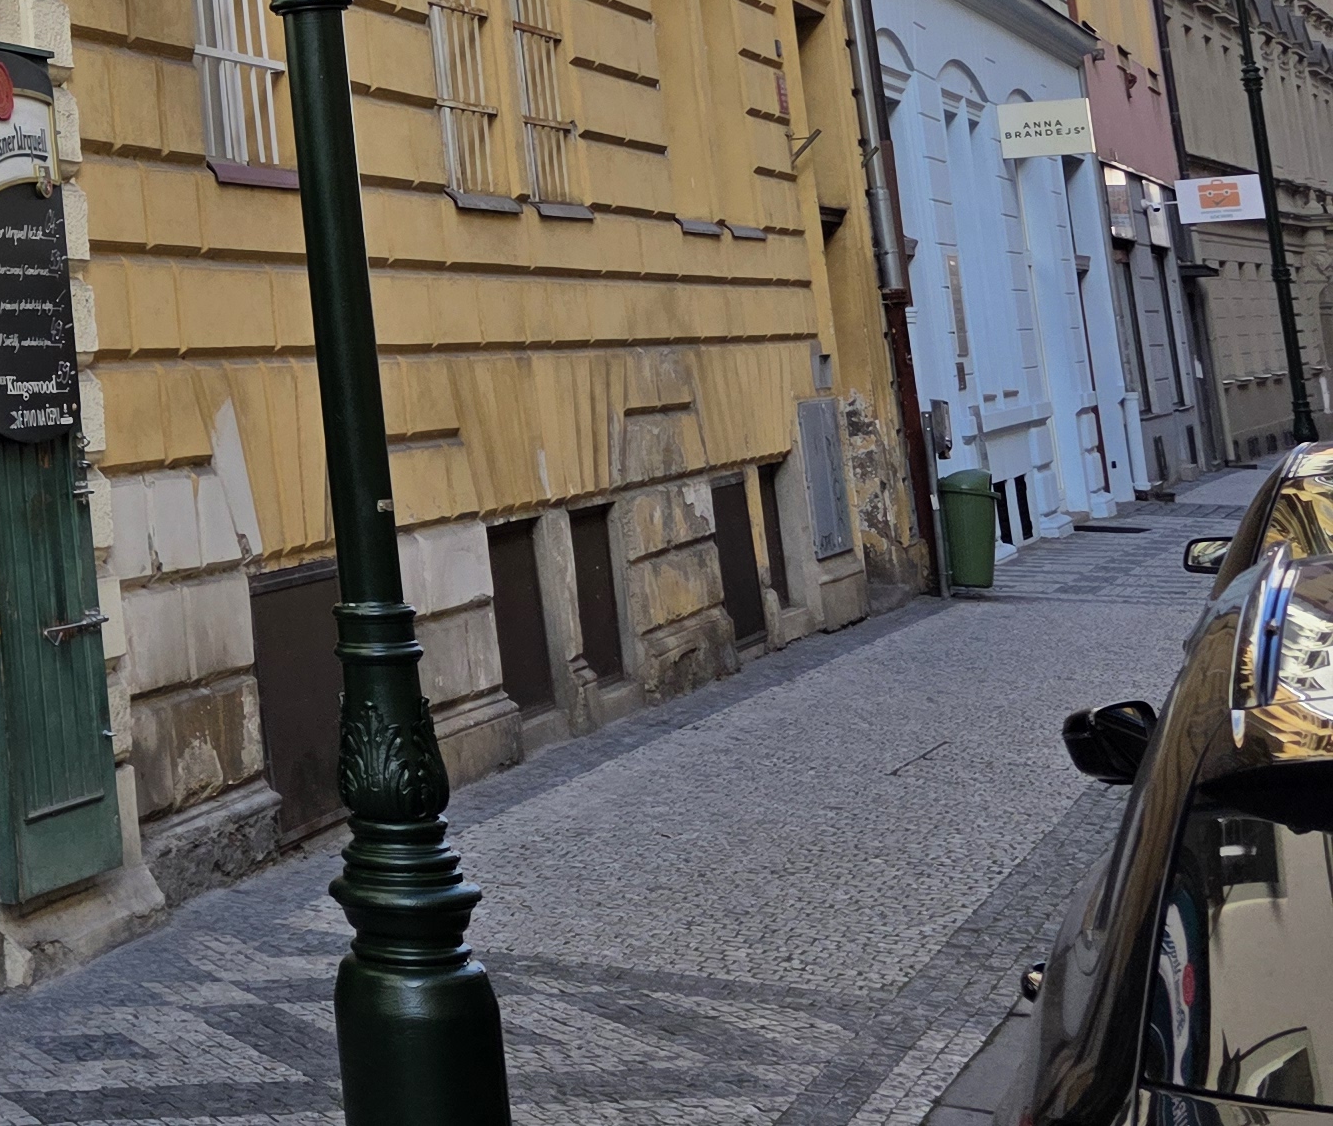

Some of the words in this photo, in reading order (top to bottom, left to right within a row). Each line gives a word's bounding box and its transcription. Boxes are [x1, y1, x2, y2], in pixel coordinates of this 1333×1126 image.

[1004, 127, 1081, 140] BRANDEJS
[1023, 119, 1062, 130] ANNA
[13, 122, 48, 164] Urquell
[6, 374, 58, 401] Kingswood
